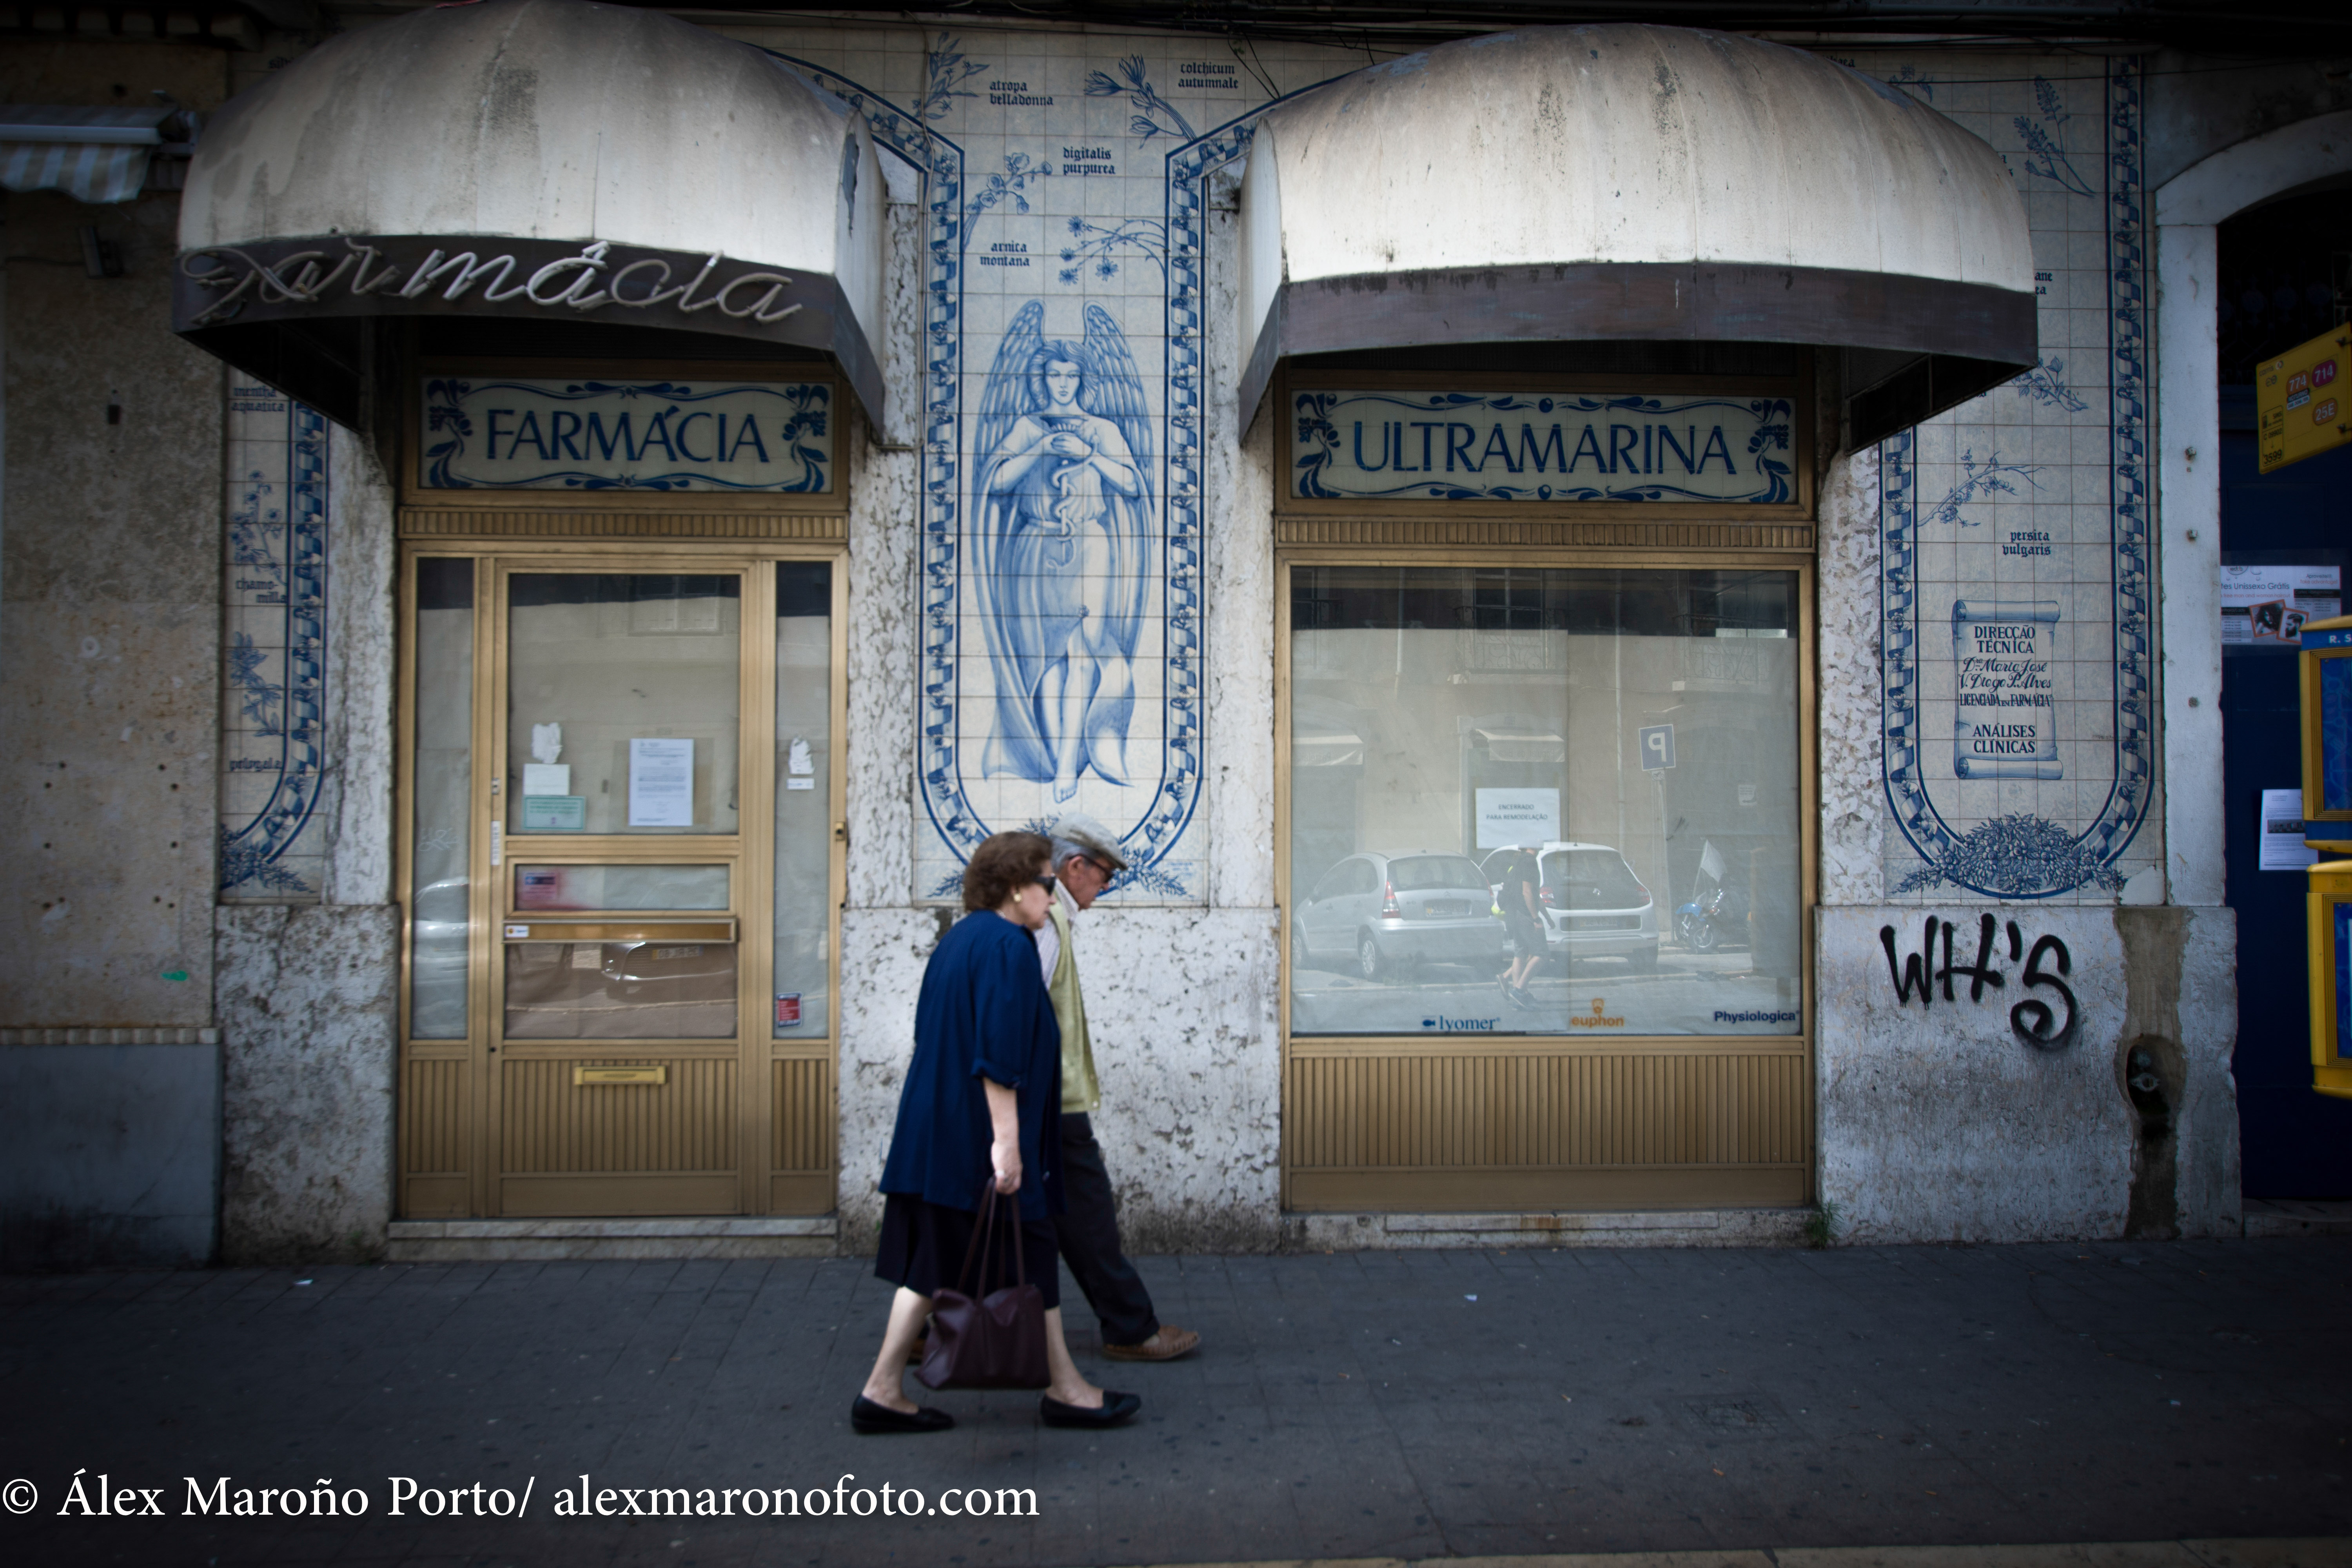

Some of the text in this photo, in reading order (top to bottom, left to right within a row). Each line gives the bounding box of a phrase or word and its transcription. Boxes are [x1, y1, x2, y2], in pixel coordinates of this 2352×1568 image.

[1180, 61, 1235, 76] colchicum
[989, 80, 1027, 93] atropa
[1178, 76, 1239, 89] autumnale
[989, 93, 1054, 106] belladonna
[1063, 146, 1112, 162] digitalis
[1063, 162, 1116, 175] purpurea
[991, 240, 1027, 253] arnica
[980, 256, 1030, 267] montana
[2314, 364, 2334, 383] 714
[2288, 374, 2307, 392] 774
[2315, 402, 2335, 421] 25E
[486, 405, 770, 463] FARMÁCIA
[1354, 421, 1738, 475] ULTRAMARINA
[2263, 449, 2282, 465] 3599
[2010, 529, 2049, 543] persica
[2002, 543, 2051, 557] vulgaris
[1974, 625, 2036, 641] DIRECÇÃO
[1976, 639, 2034, 653] TÉCNICA
[1981, 659, 2019, 673] Maria
[2018, 658, 2047, 677] José
[1971, 673, 2005, 693] Diogo
[1972, 723, 2036, 738] ANÁLISES
[1973, 738, 2036, 753] CLÍNICAS
[1503, 813, 1548, 821] REMODELAÇÃO
[1571, 1015, 1624, 1029] euphon
